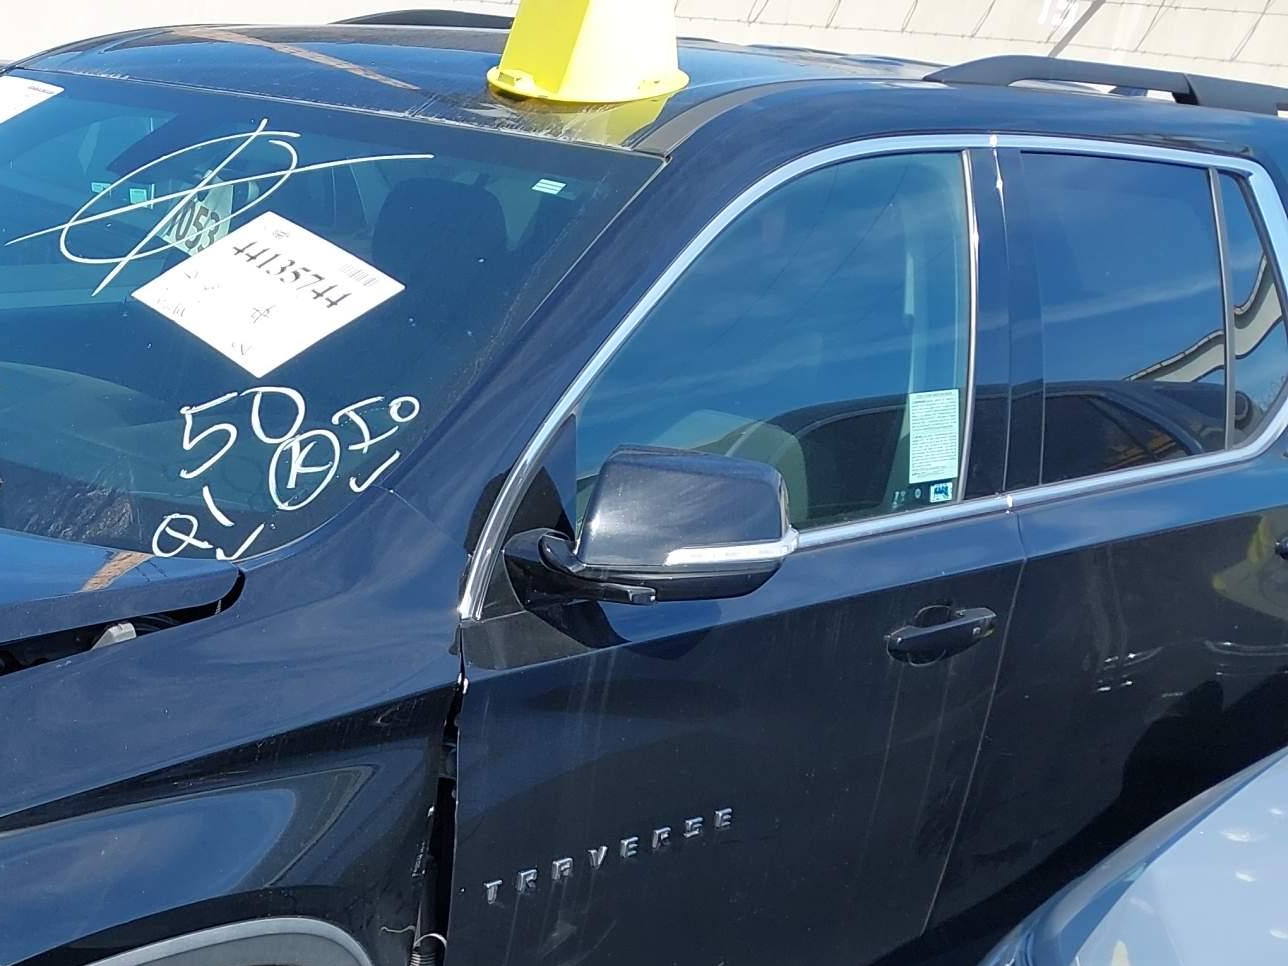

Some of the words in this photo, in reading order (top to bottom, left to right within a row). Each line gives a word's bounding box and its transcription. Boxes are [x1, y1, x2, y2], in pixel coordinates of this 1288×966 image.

[232, 241, 353, 308] 44135744
[179, 386, 306, 479] 50
[483, 807, 733, 905] TRAVERSE
